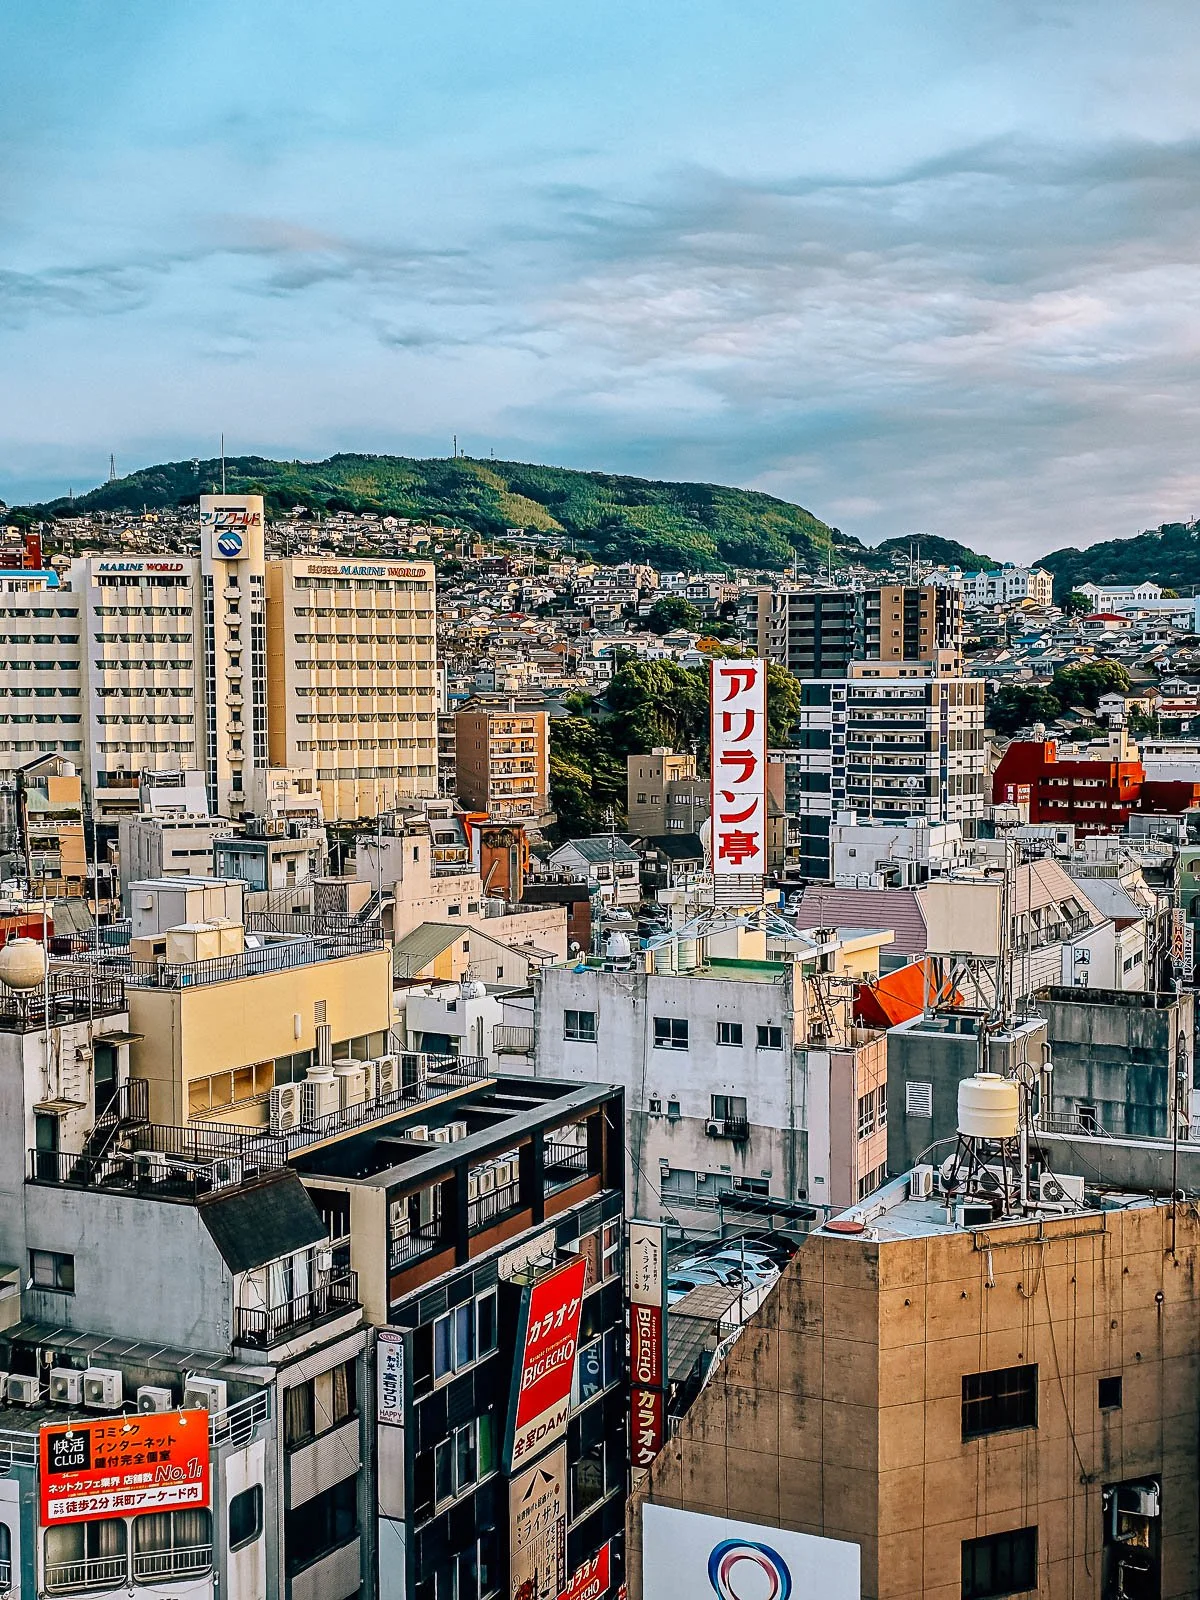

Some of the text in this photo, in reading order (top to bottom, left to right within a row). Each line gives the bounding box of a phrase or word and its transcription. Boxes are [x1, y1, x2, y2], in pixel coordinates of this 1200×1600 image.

[200, 512, 261, 525] マリンワールド
[99, 563, 183, 571] MARINE WORLD
[341, 565, 386, 577] MARINE
[388, 567, 427, 578] WORLD
[719, 667, 760, 865] アリラン亭
[642, 1245, 651, 1292] ミライザカ
[527, 1297, 581, 1346] カラオケ
[638, 1307, 651, 1383] BIG ECHO
[521, 1339, 574, 1391] BIG ECHO
[380, 1409, 402, 1420] HAPPY
[637, 1390, 656, 1465] カラオケ
[53, 1437, 85, 1455] 快活
[95, 1435, 176, 1454] インターネット
[514, 1407, 568, 1461] 全室DAM
[54, 1454, 85, 1467] CLUB
[48, 1475, 121, 1494] ネットカフェ業界
[123, 1471, 153, 1484] 店舗数
[66, 1499, 109, 1514] 徒歩2分
[113, 1487, 198, 1508] 浜町アーケード内
[517, 1499, 560, 1545] ミライザカ
[567, 1554, 600, 1595] カラオケ
